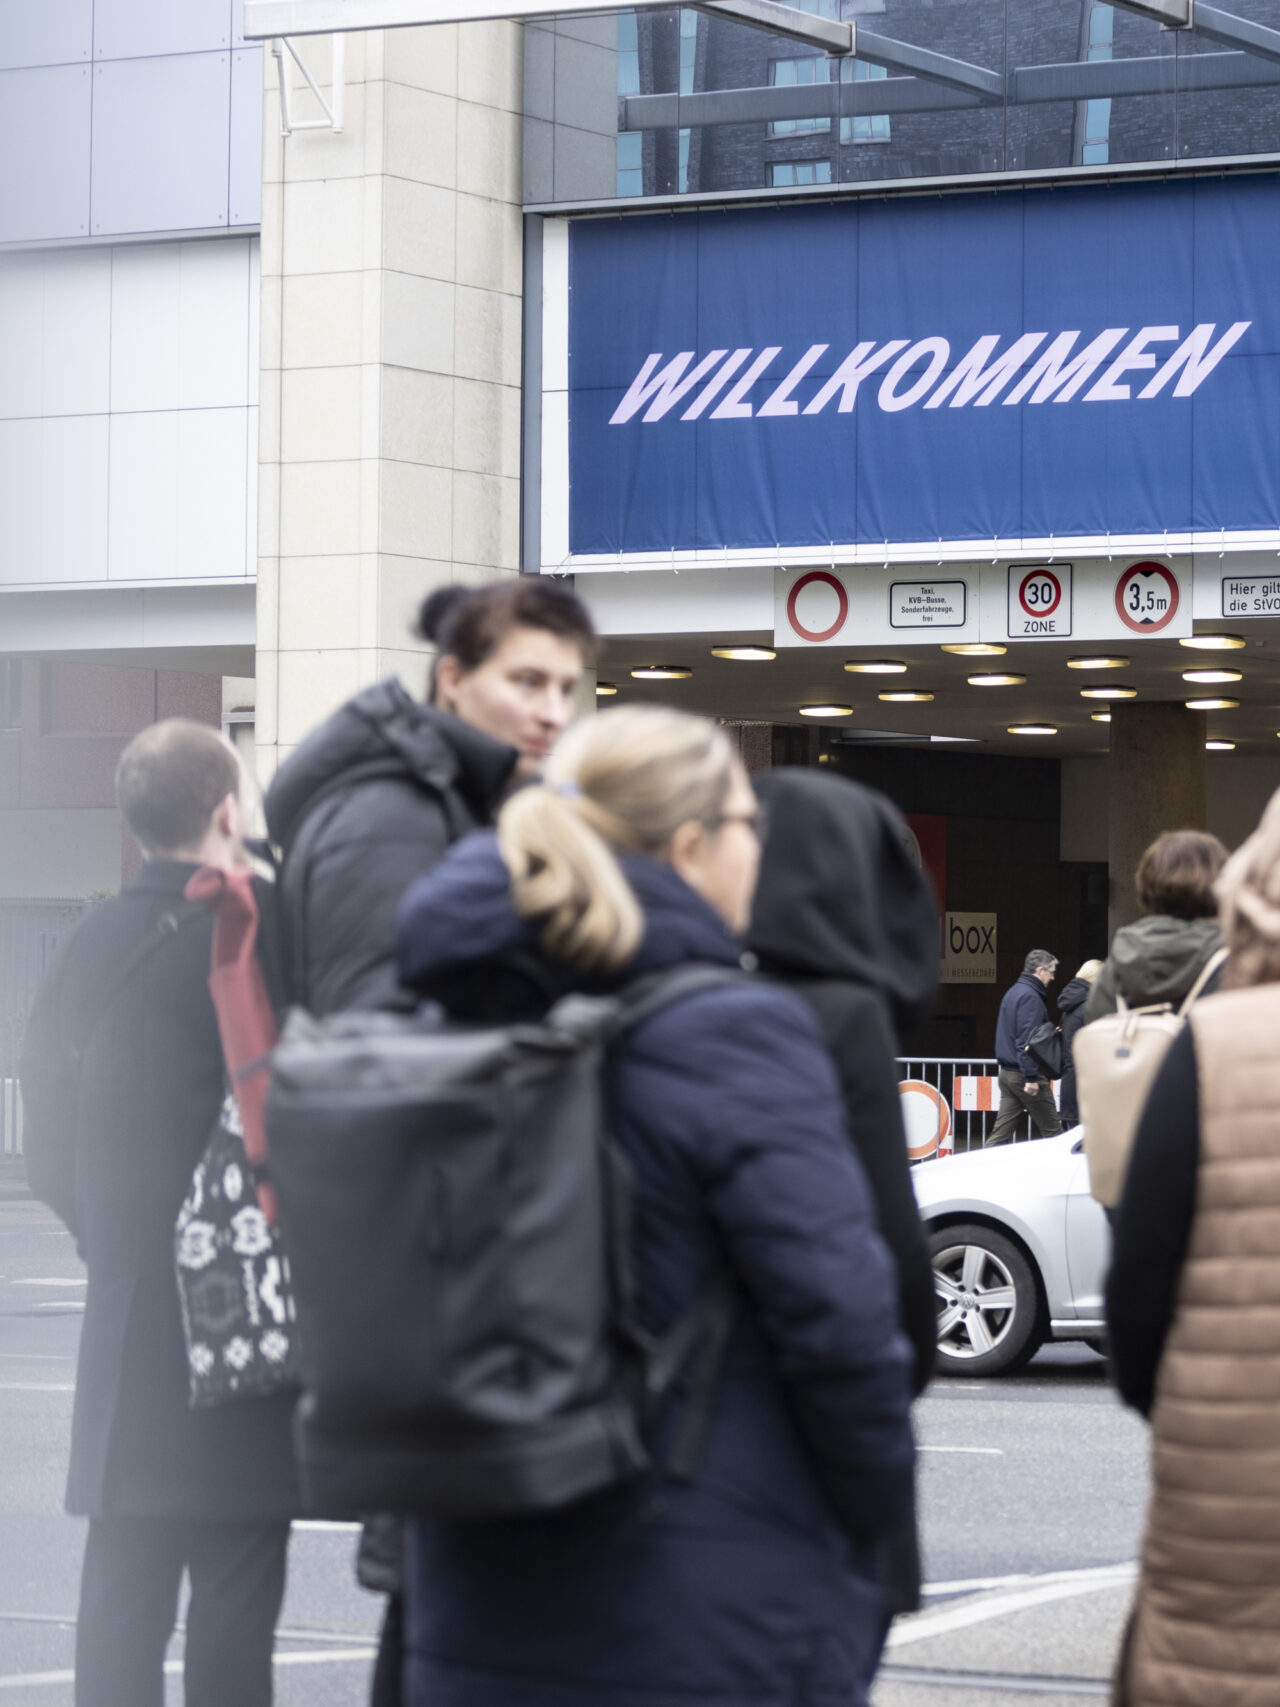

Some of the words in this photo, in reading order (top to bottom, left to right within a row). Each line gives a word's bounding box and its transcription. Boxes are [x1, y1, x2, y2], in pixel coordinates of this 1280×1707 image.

[608, 321, 1253, 425] WILLKOMMEN
[921, 587, 935, 595] Taxi,
[1027, 583, 1053, 605] 30
[1230, 583, 1256, 595] Hier
[1262, 582, 1280, 597] gilt
[1229, 599, 1247, 611] die
[922, 614, 933, 622] frei
[1024, 620, 1056, 633] ZONE
[950, 917, 995, 954] box
